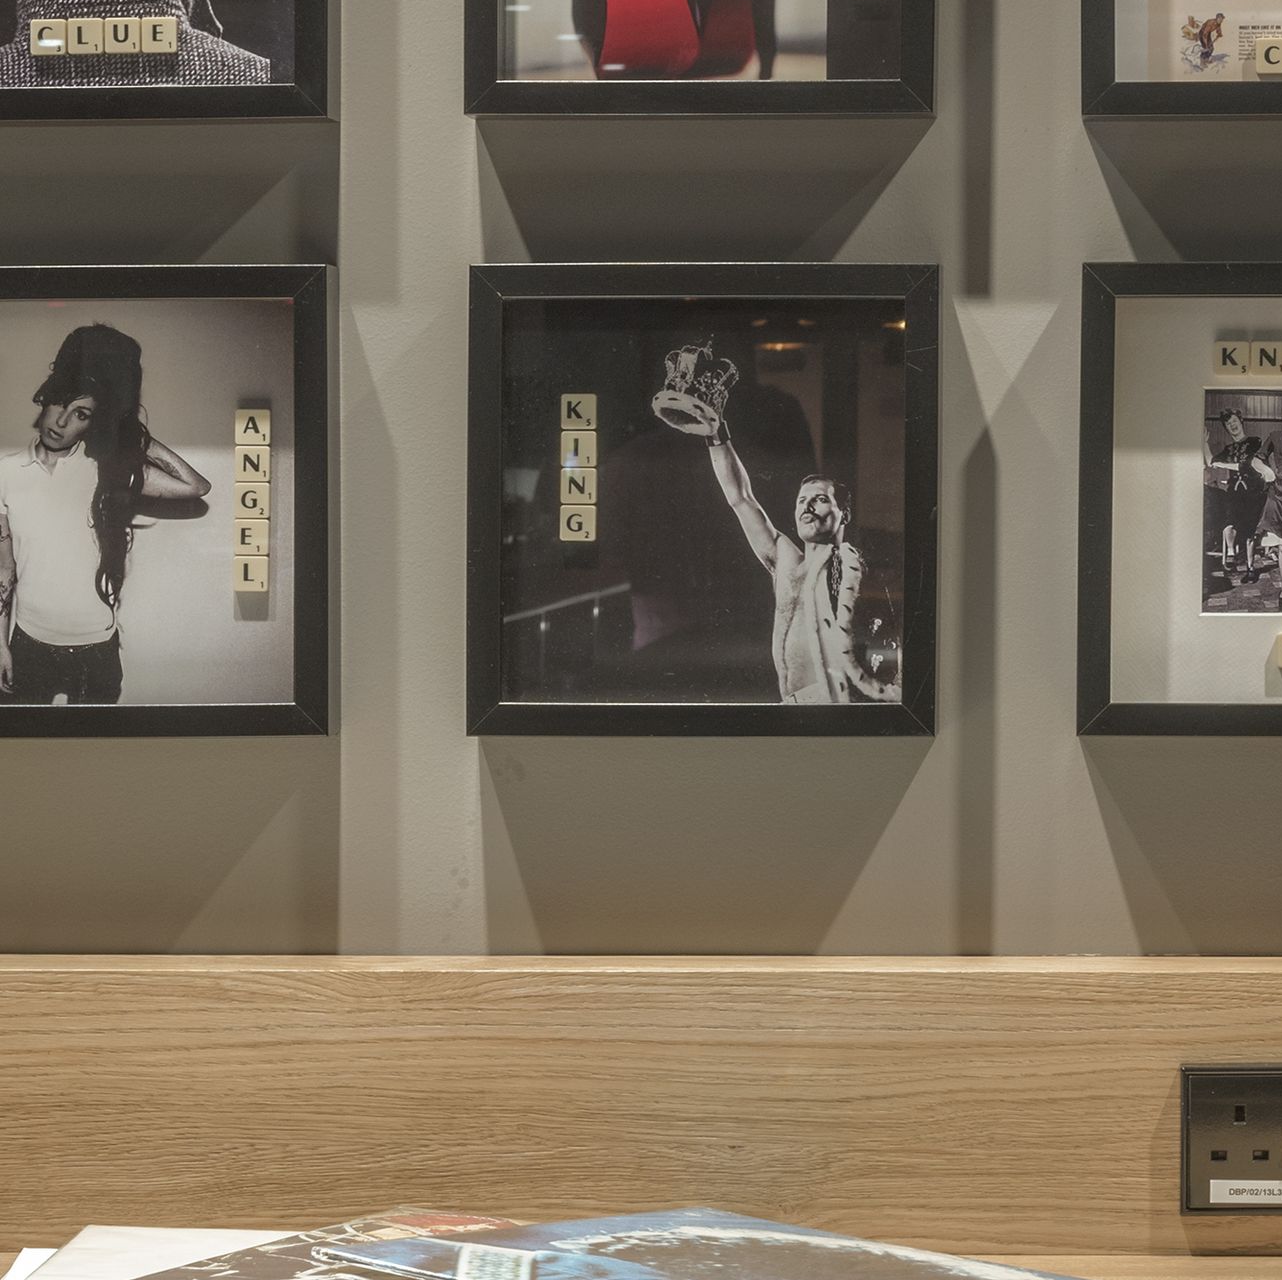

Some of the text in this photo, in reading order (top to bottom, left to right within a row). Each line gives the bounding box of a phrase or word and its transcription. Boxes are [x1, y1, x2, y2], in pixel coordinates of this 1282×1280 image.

[36, 24, 172, 52] CLUE
[240, 415, 267, 588] ANGEL
[565, 400, 592, 539] KING
[1228, 1187, 1282, 1197] DBP/02/13L3
